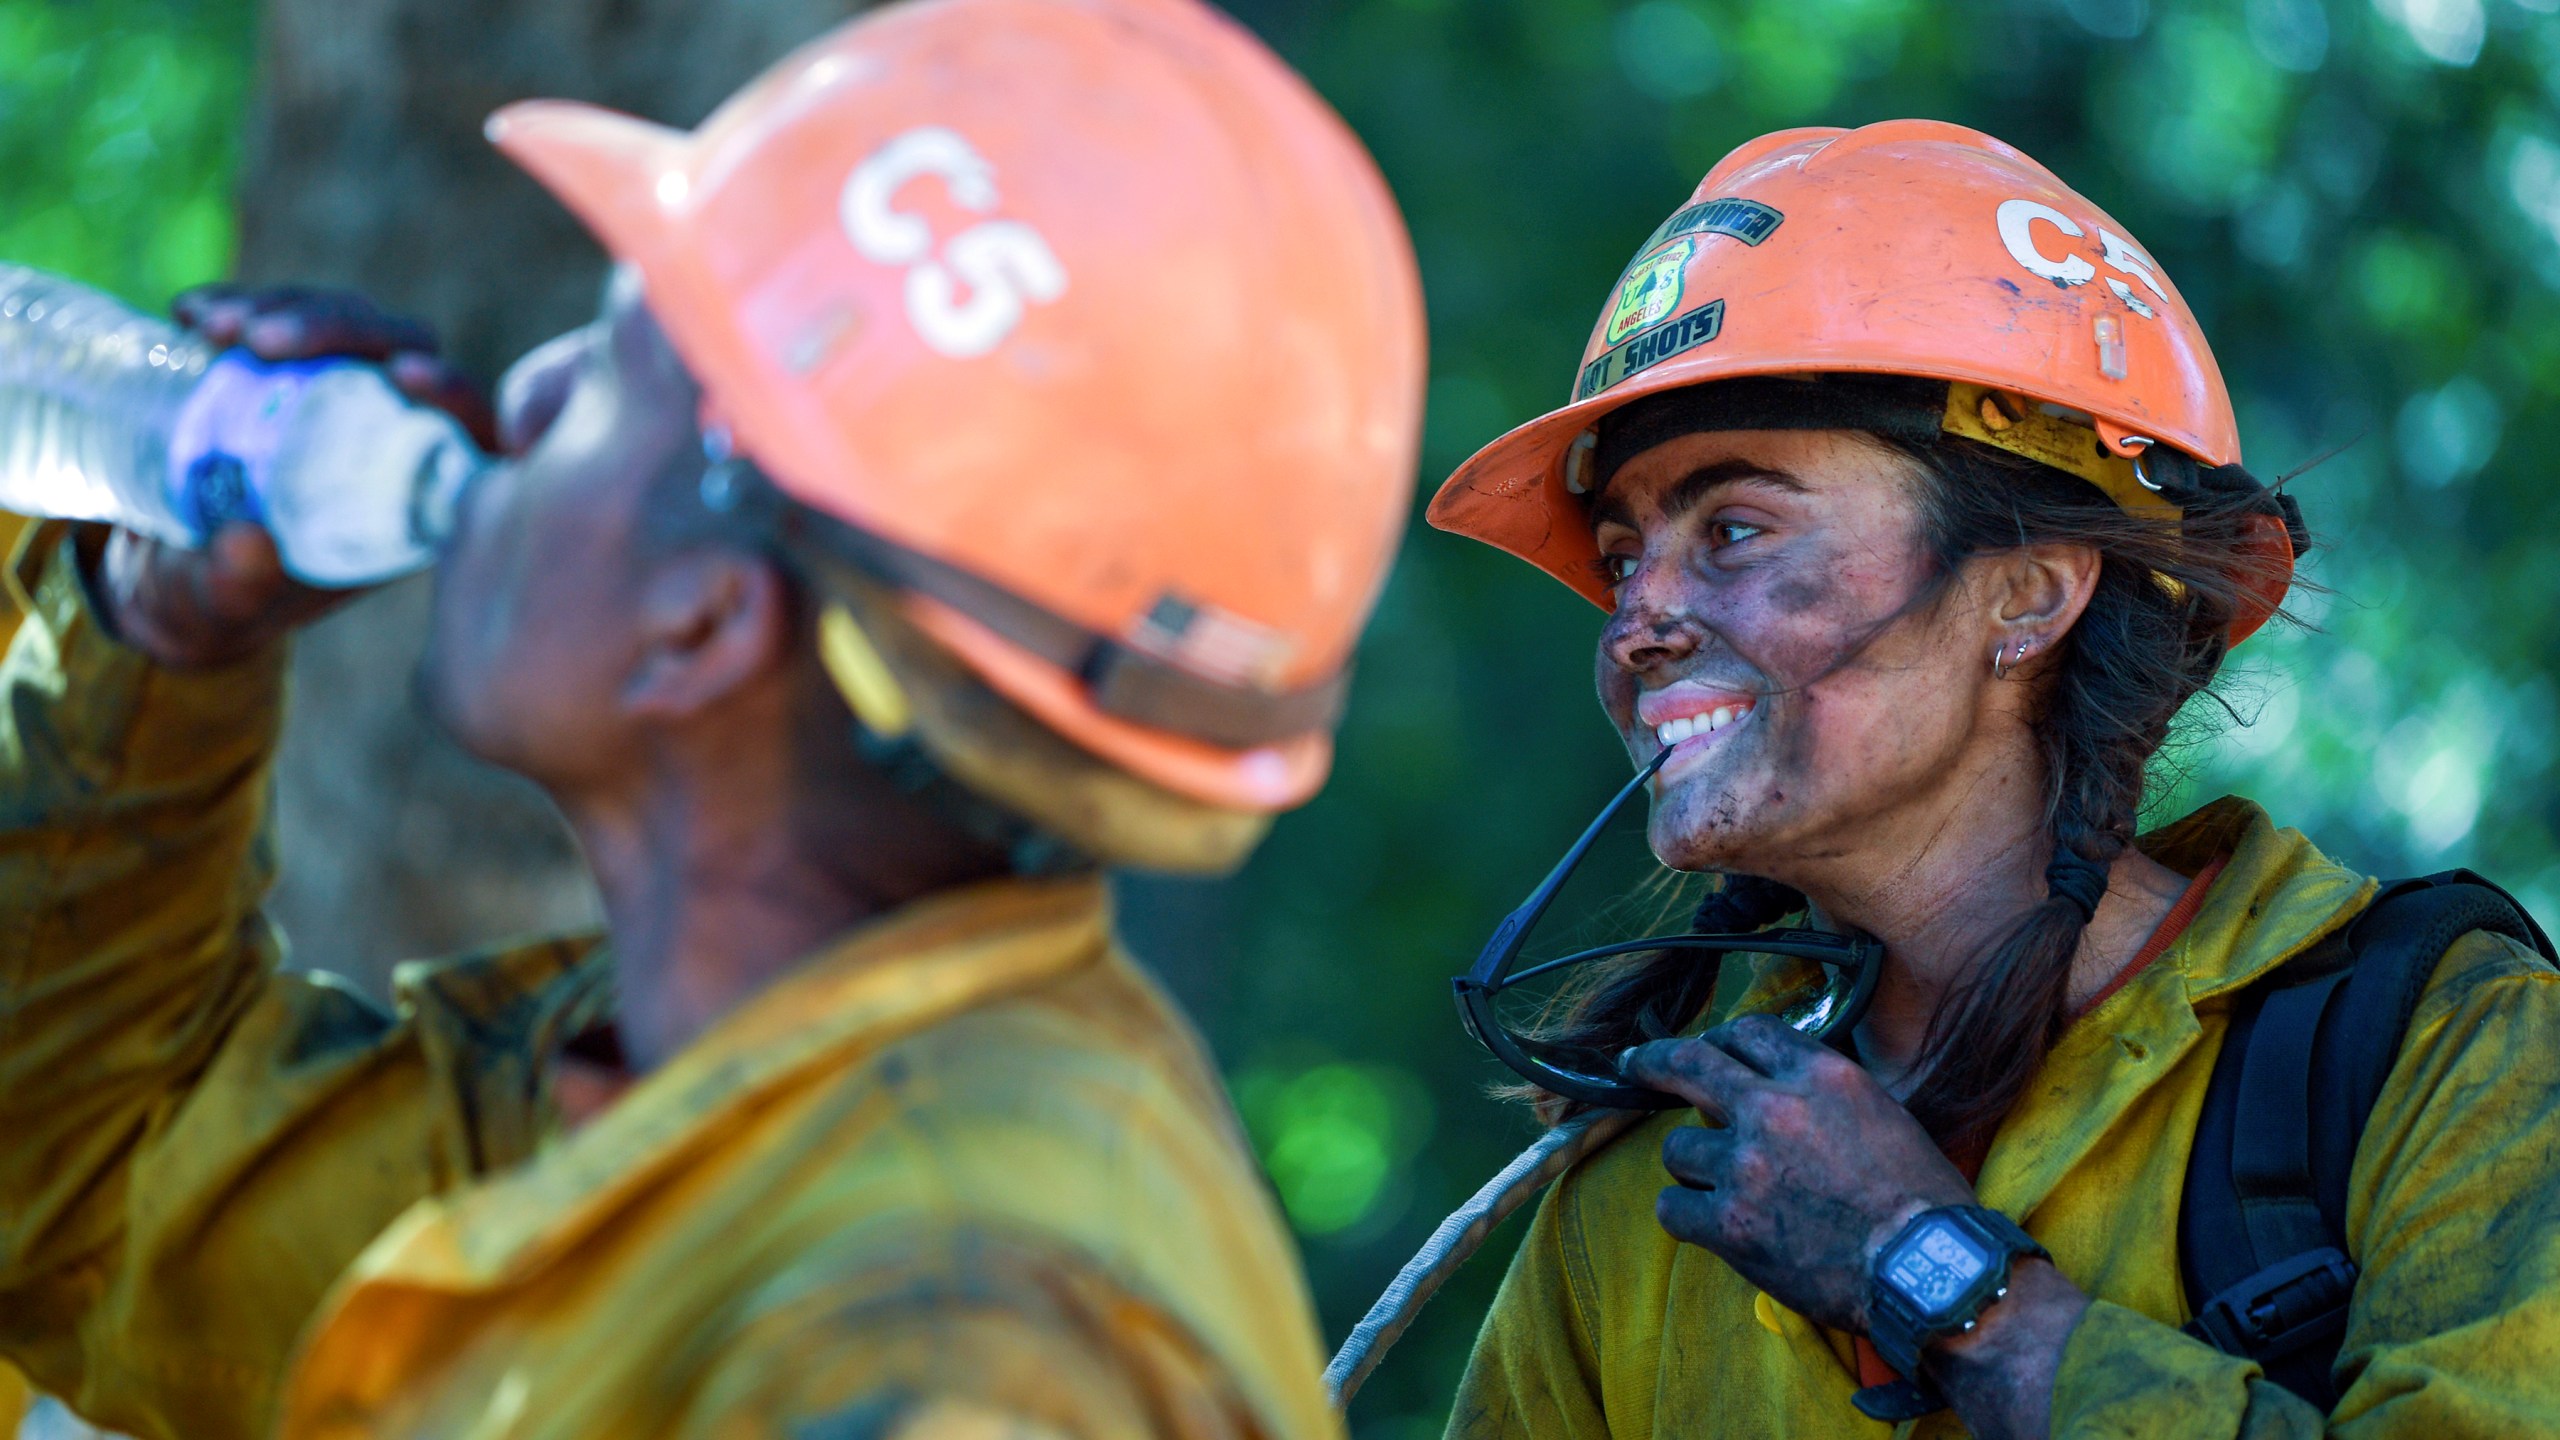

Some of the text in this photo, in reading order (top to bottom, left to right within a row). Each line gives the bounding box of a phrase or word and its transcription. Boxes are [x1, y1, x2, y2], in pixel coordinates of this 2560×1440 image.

[840, 124, 1068, 358] C5
[1996, 199, 2168, 320] C5
[1617, 300, 1662, 333] ANGELES
[1623, 307, 1714, 375] SHOTS
